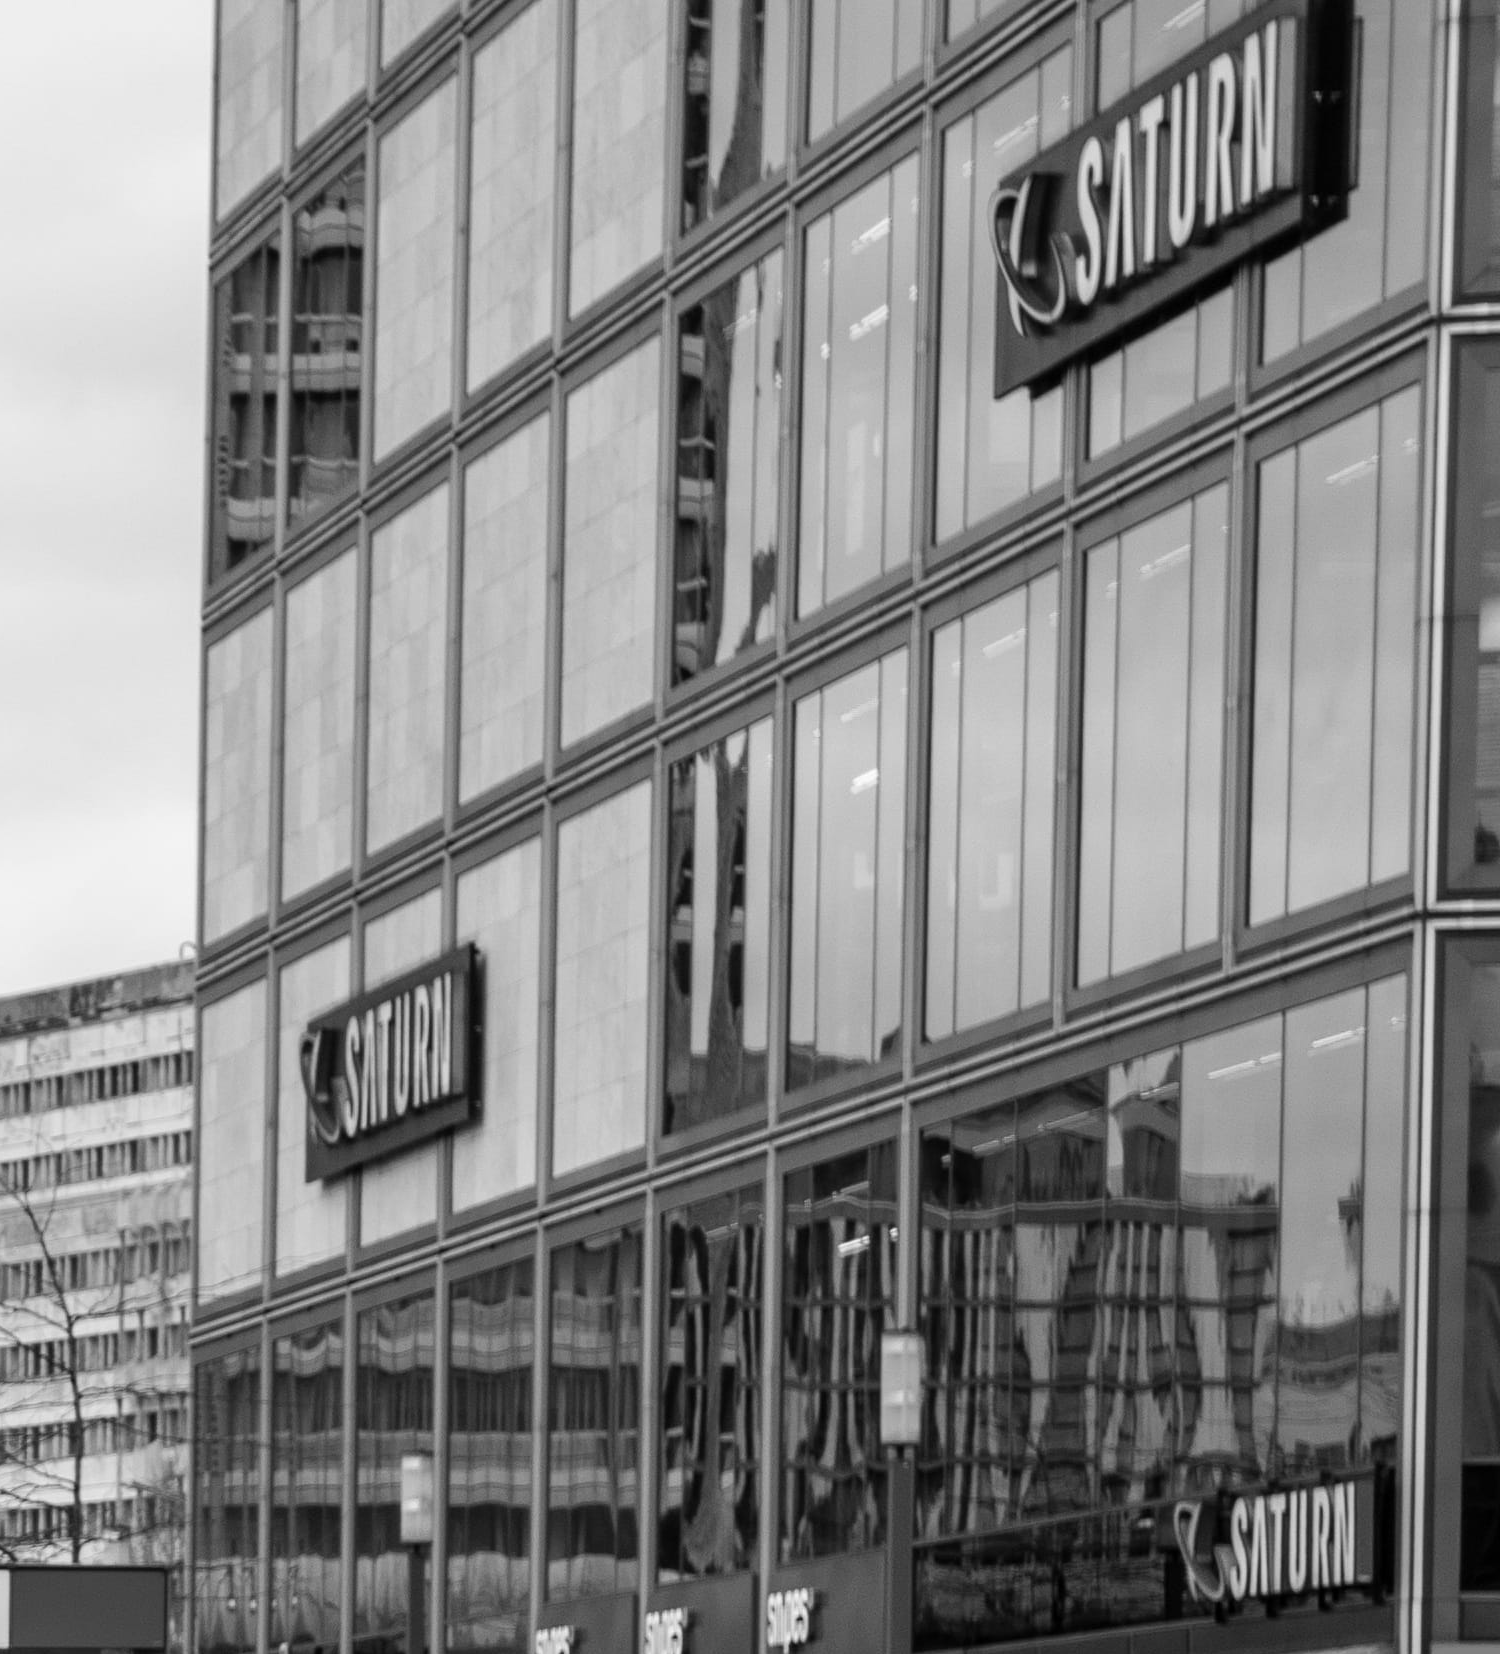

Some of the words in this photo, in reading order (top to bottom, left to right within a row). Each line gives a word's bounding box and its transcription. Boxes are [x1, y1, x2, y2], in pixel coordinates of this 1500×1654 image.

[1076, 19, 1279, 305] SATURN
[344, 971, 451, 1138] SATURN
[1230, 1481, 1355, 1600] SATURN
